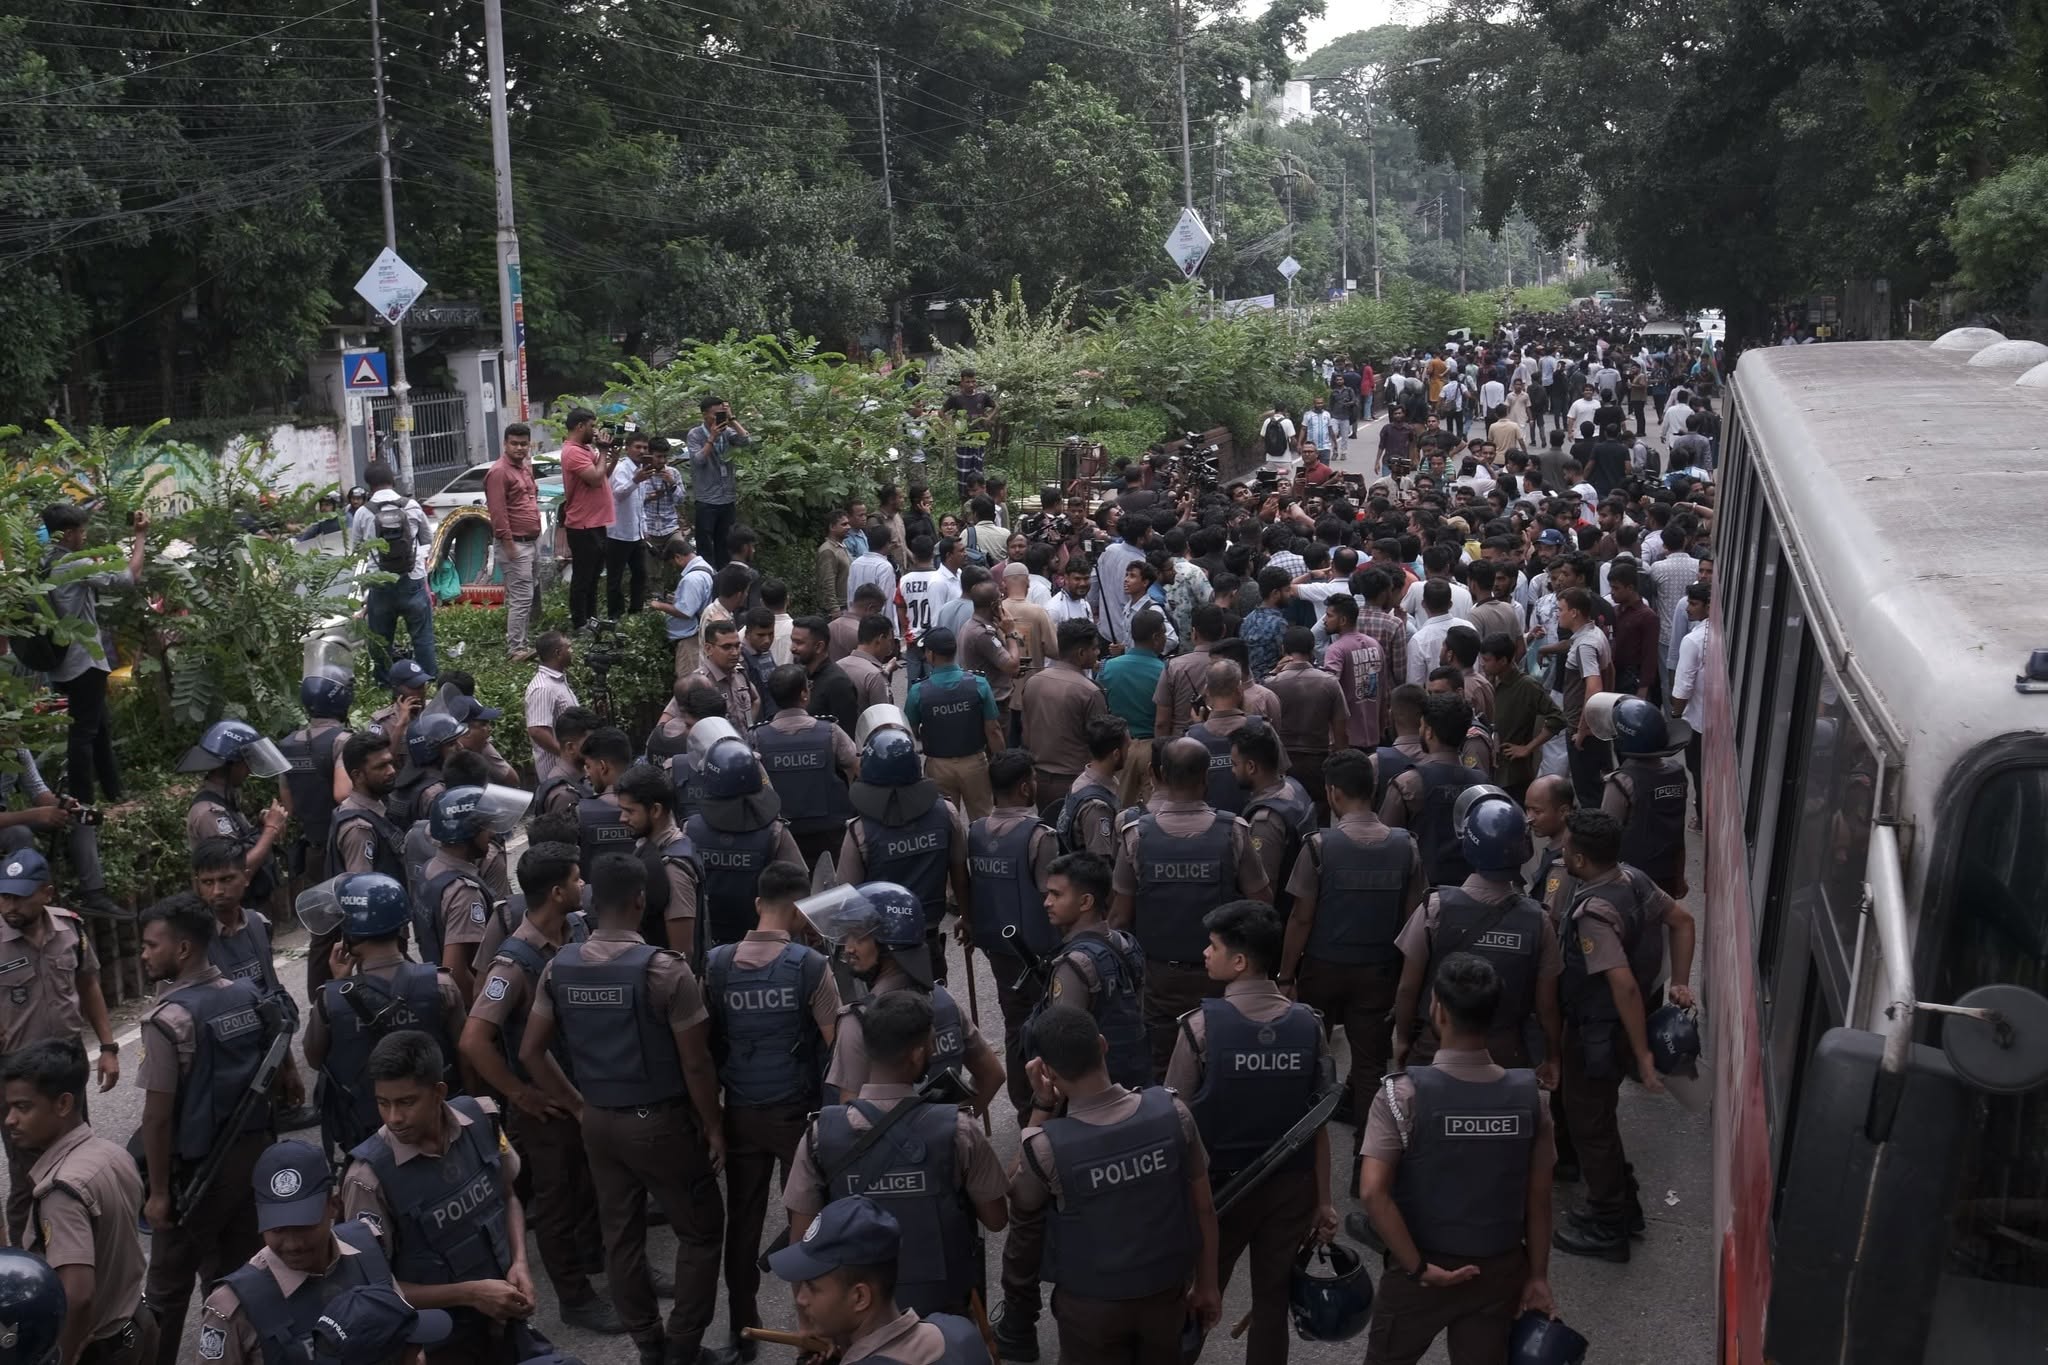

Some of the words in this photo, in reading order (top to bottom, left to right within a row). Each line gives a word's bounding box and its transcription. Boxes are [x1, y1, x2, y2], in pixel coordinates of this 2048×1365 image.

[905, 581, 928, 595] REZA
[908, 599, 931, 630] 10
[932, 700, 971, 717] POLICE
[223, 729, 244, 743] POLICE
[1616, 722, 1638, 737] POLICE
[409, 735, 425, 745] POLICE
[774, 753, 818, 768] POLICE
[1209, 757, 1233, 767] POLI
[446, 802, 476, 815] POLICE
[601, 829, 632, 840] POLI
[888, 833, 937, 856] POLICE
[701, 851, 751, 868] POLICE
[974, 856, 1009, 874] POLICE
[1154, 862, 1211, 879] POLICE
[340, 895, 368, 906] POLICE
[886, 905, 913, 916] POLICE
[1476, 935, 1515, 947] OLICE
[573, 989, 617, 1002] POLICE
[1235, 1052, 1301, 1072] POLICE
[1452, 1119, 1511, 1133] POLICE
[1090, 1148, 1168, 1189] POLICE
[432, 1174, 495, 1231] POLICE
